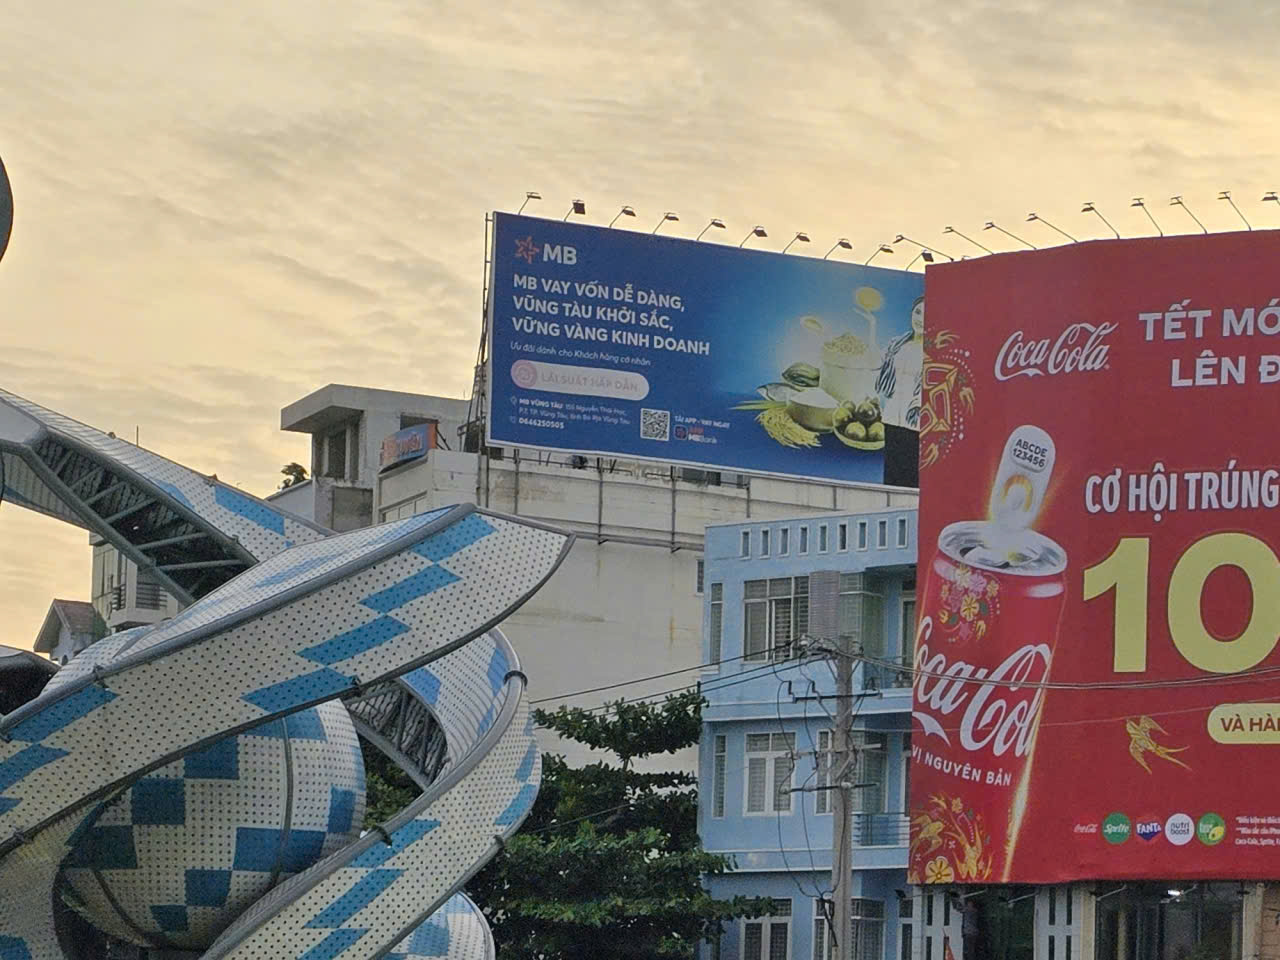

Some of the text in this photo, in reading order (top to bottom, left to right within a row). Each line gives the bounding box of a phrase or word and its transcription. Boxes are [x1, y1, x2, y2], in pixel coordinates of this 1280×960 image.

[543, 243, 577, 265] MB
[513, 274, 685, 312] MB VAY VỐN DỄ DÀNG,
[513, 295, 673, 331] VŨNG TÀU KHỞI SẮC,
[1139, 300, 1212, 342] TẾT
[512, 316, 710, 355] VỮNG VÀNG KINH DOANH
[558, 348, 573, 357] cho
[574, 350, 599, 359] Khách
[1171, 351, 1246, 387] LÊN
[1013, 448, 1046, 468] 123456
[1015, 438, 1048, 458] ABCDE
[1085, 467, 1122, 513] CƠ
[1129, 462, 1177, 522] HỘI
[1220, 713, 1245, 732] VÀ
[924, 752, 982, 782] NGUYÊN
[986, 768, 1012, 786] BẢN
[1170, 828, 1190, 836] boost
